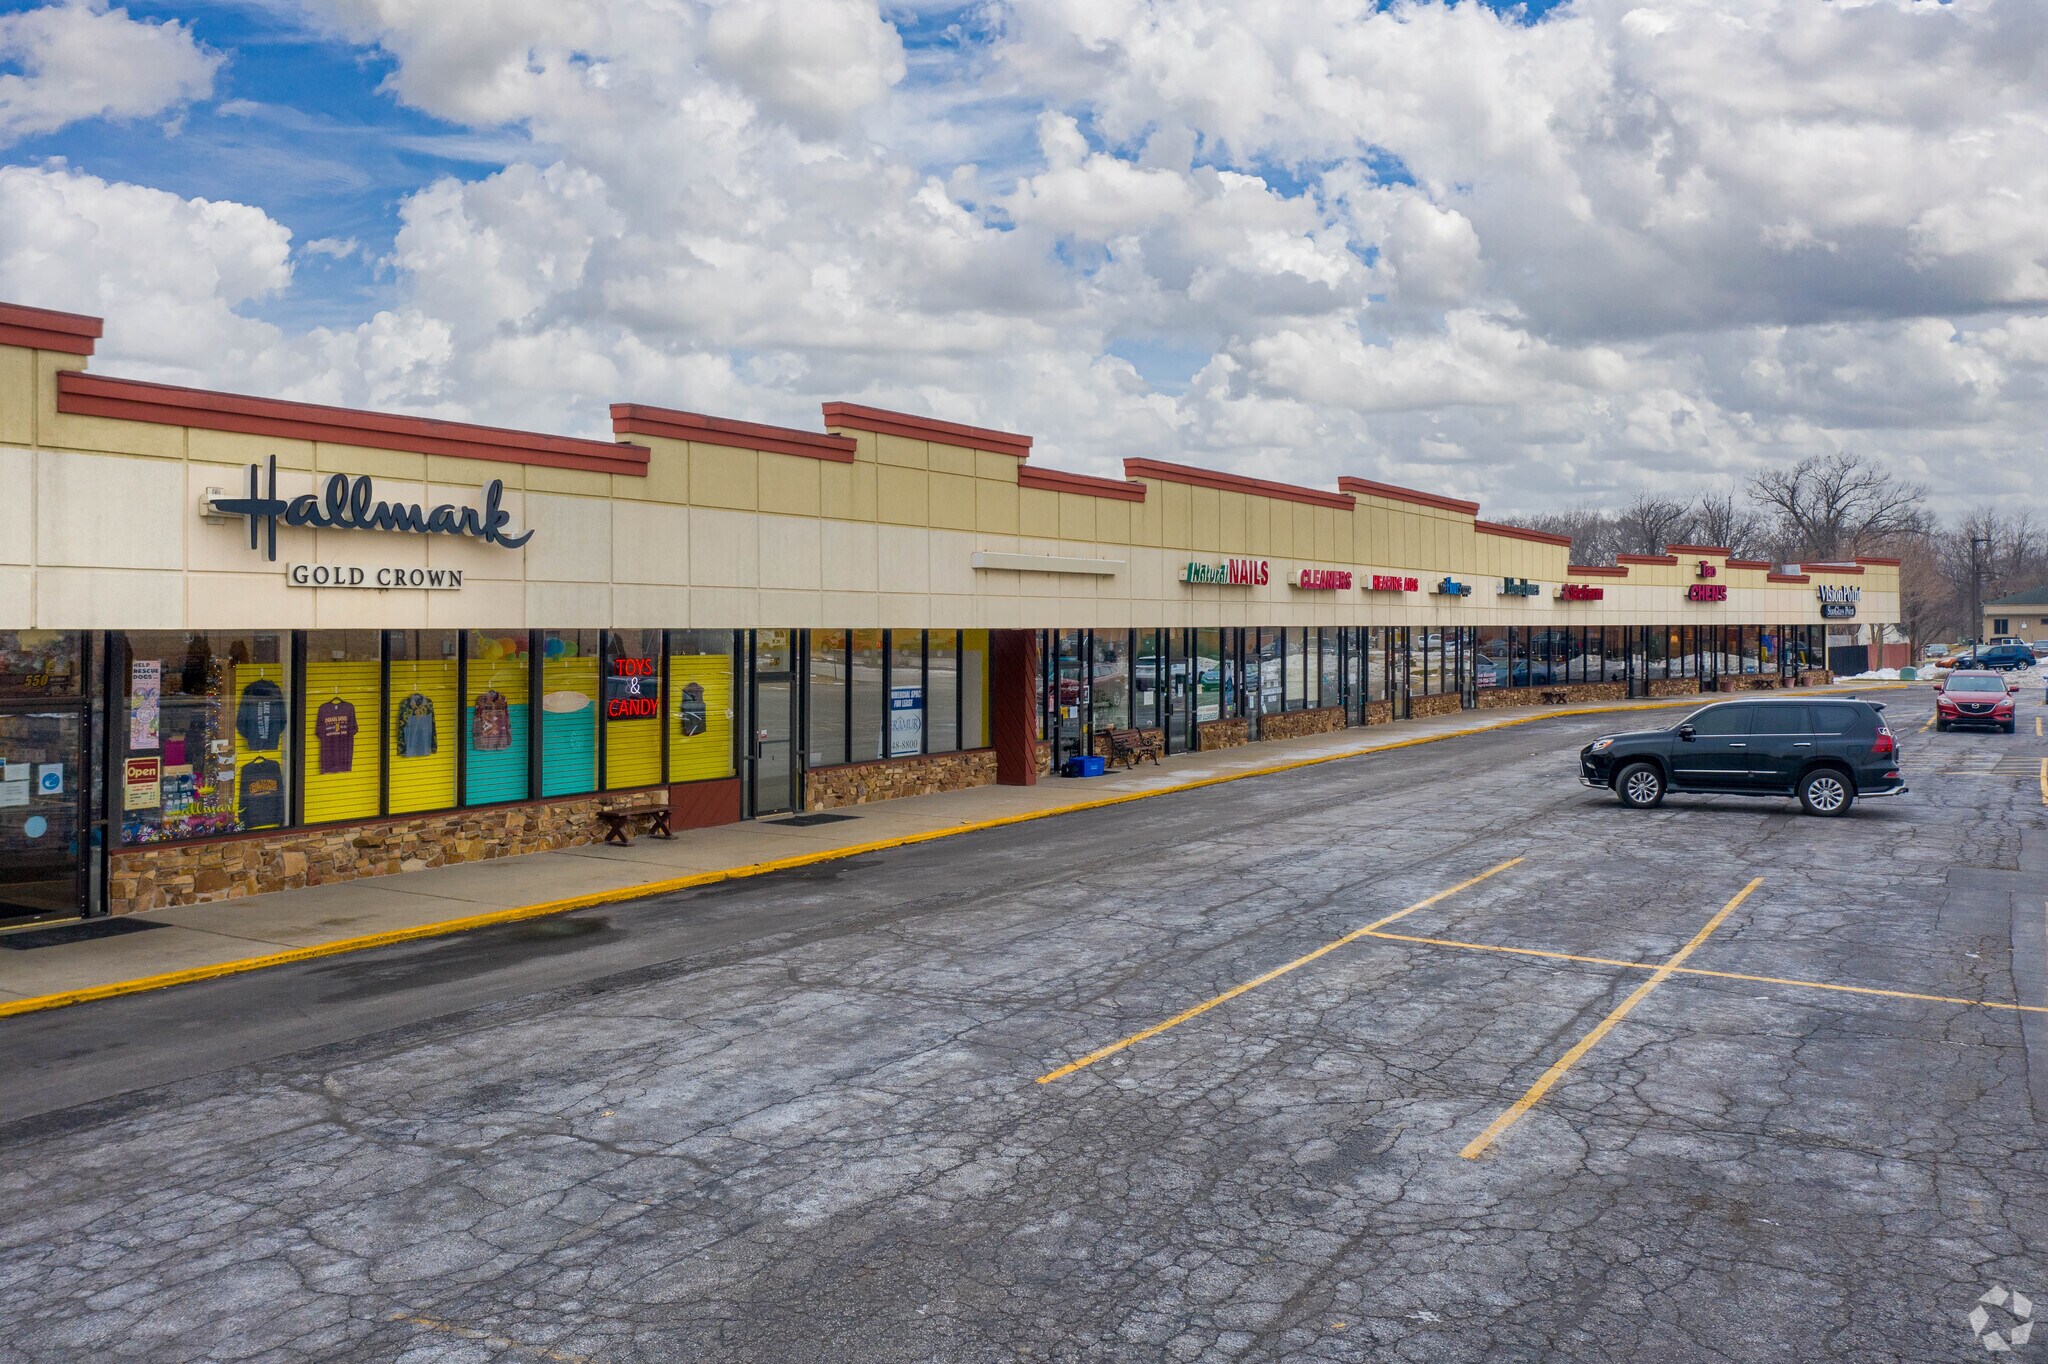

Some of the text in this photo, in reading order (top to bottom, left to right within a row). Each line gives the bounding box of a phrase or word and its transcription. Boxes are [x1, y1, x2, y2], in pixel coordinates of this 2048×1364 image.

[209, 454, 535, 561] Hallmark
[293, 565, 463, 587] GOLD CROWN
[1187, 559, 1268, 585] Natural NAILS
[1700, 560, 1716, 578] Tao
[1300, 569, 1352, 590] CLEANERS
[1373, 575, 1403, 592] HEARING
[1404, 577, 1419, 592] AIDS
[615, 658, 653, 676] TOYS
[25, 674, 48, 687] 550
[630, 676, 641, 694] &
[609, 698, 659, 717] CANDY
[128, 766, 156, 778] Open
